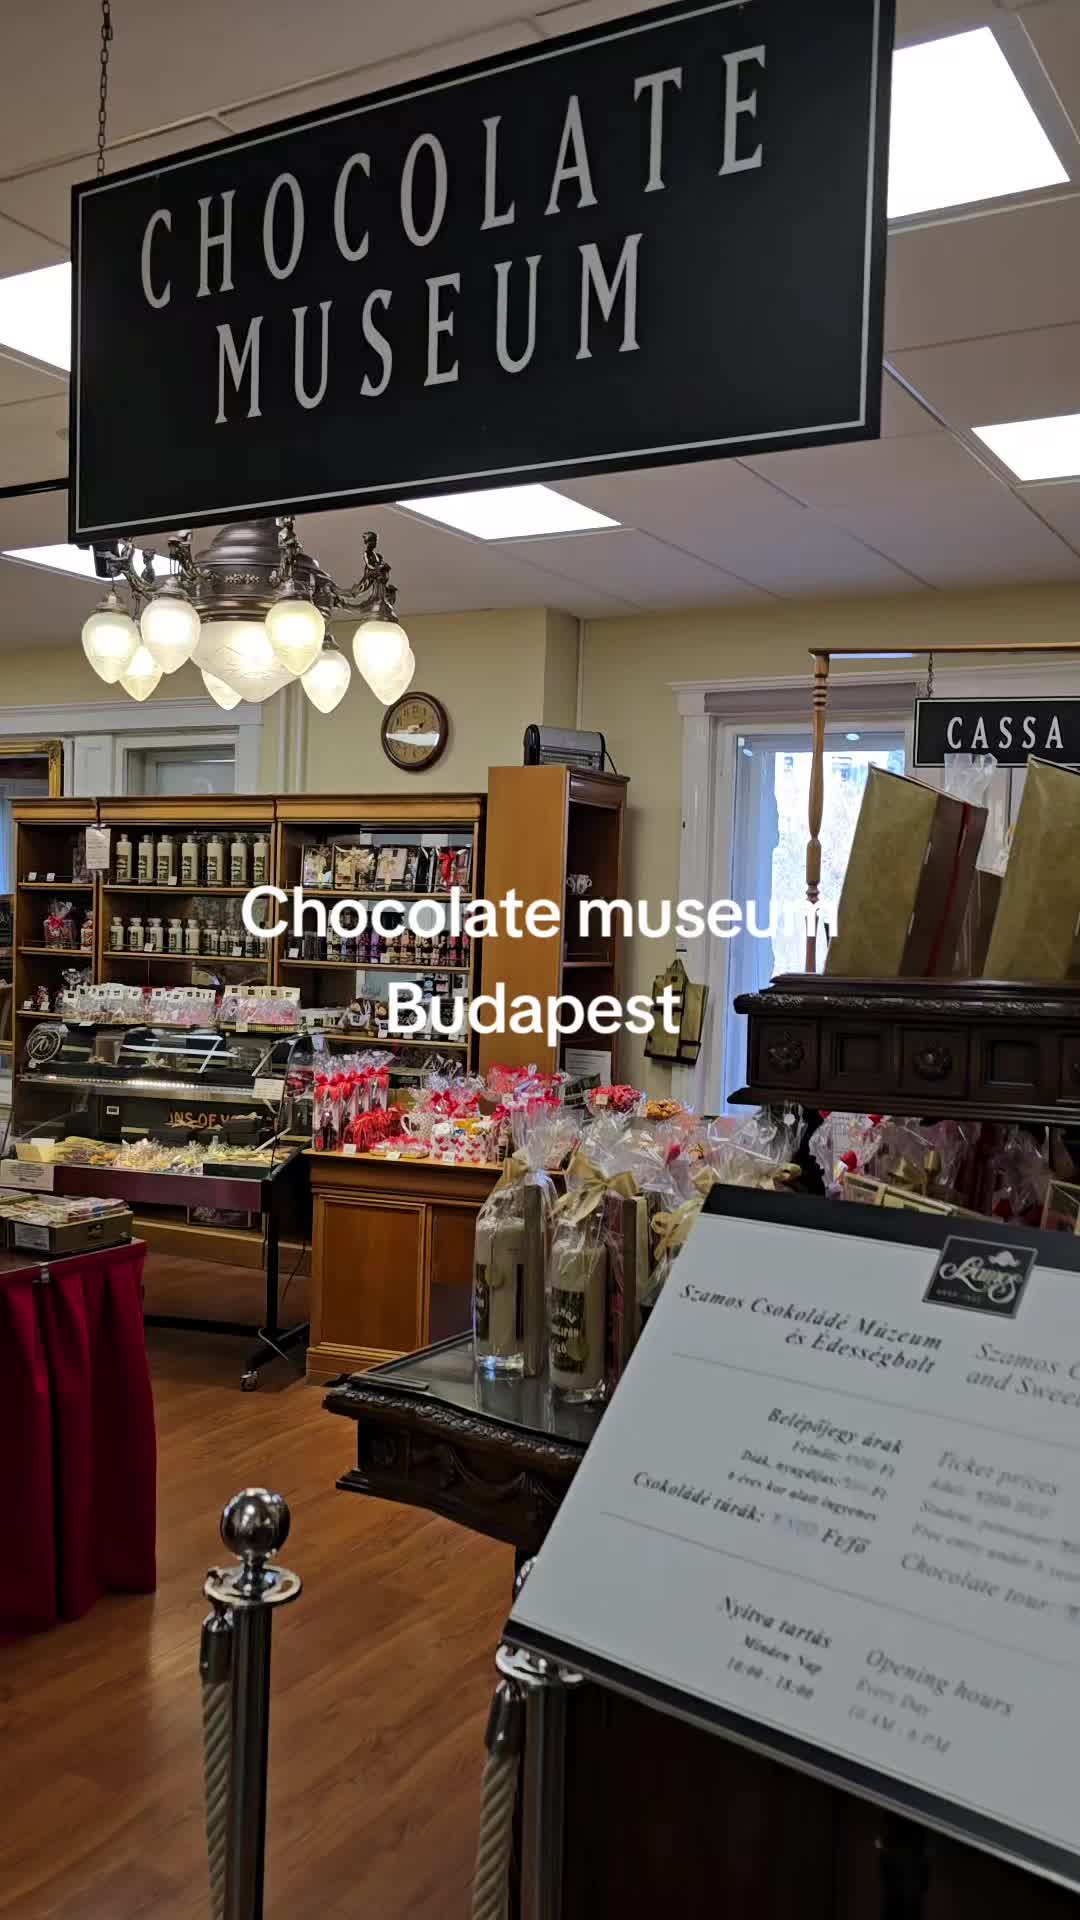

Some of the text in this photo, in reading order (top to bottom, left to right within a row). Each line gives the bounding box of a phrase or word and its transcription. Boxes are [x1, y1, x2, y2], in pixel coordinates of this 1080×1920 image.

[141, 45, 766, 309] CHOCOLATE
[214, 233, 643, 424] MUSEUM
[946, 715, 1064, 750] CASSA
[680, 1283, 943, 1351] Szamos Csokoládé Múzeum
[976, 1341, 1060, 1374] Szamos
[966, 1371, 1014, 1391] and
[633, 1471, 713, 1505] Csokoládé
[901, 1552, 1000, 1597] Chocolate
[866, 1648, 1015, 1718] Opening hours
